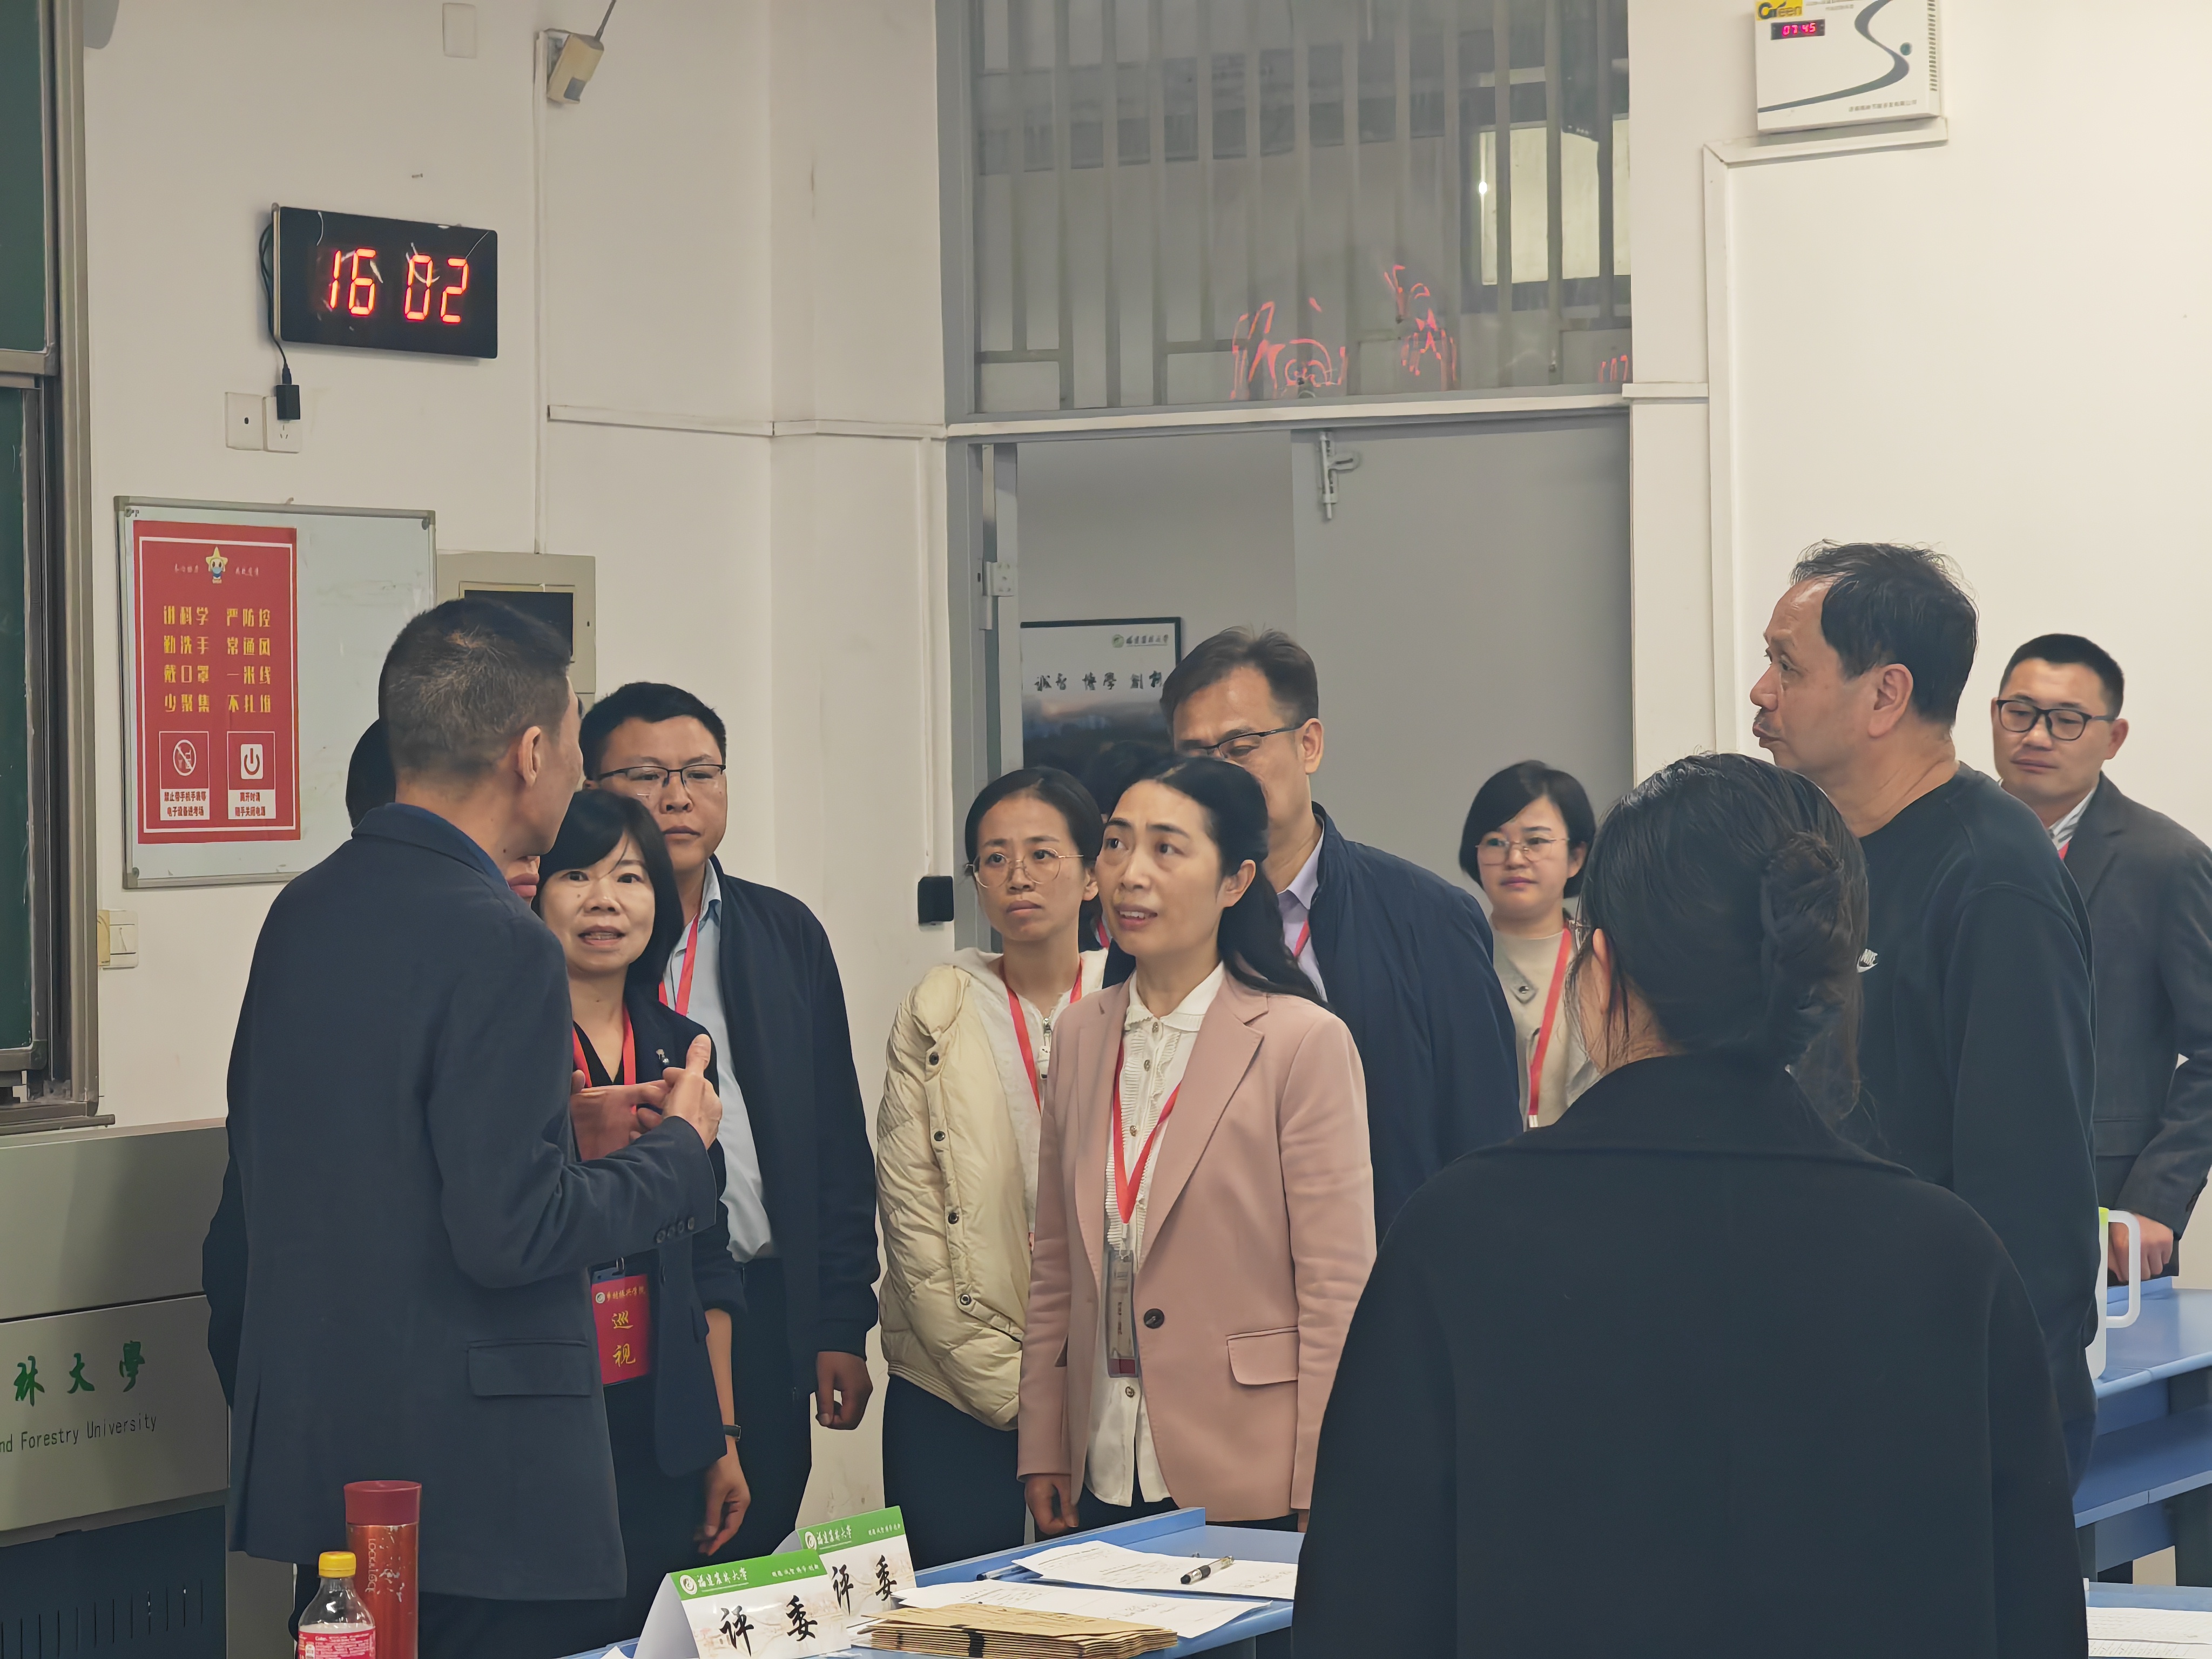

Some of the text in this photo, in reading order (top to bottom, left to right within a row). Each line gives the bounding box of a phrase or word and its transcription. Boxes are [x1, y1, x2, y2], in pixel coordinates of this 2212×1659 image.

[329, 248, 469, 324] 16 02
[164, 665, 209, 683] 戴口罩
[165, 694, 210, 712] 少聚集
[21, 1428, 79, 1451] Forestry
[87, 1413, 157, 1439] University
[719, 1595, 818, 1657] 评委
